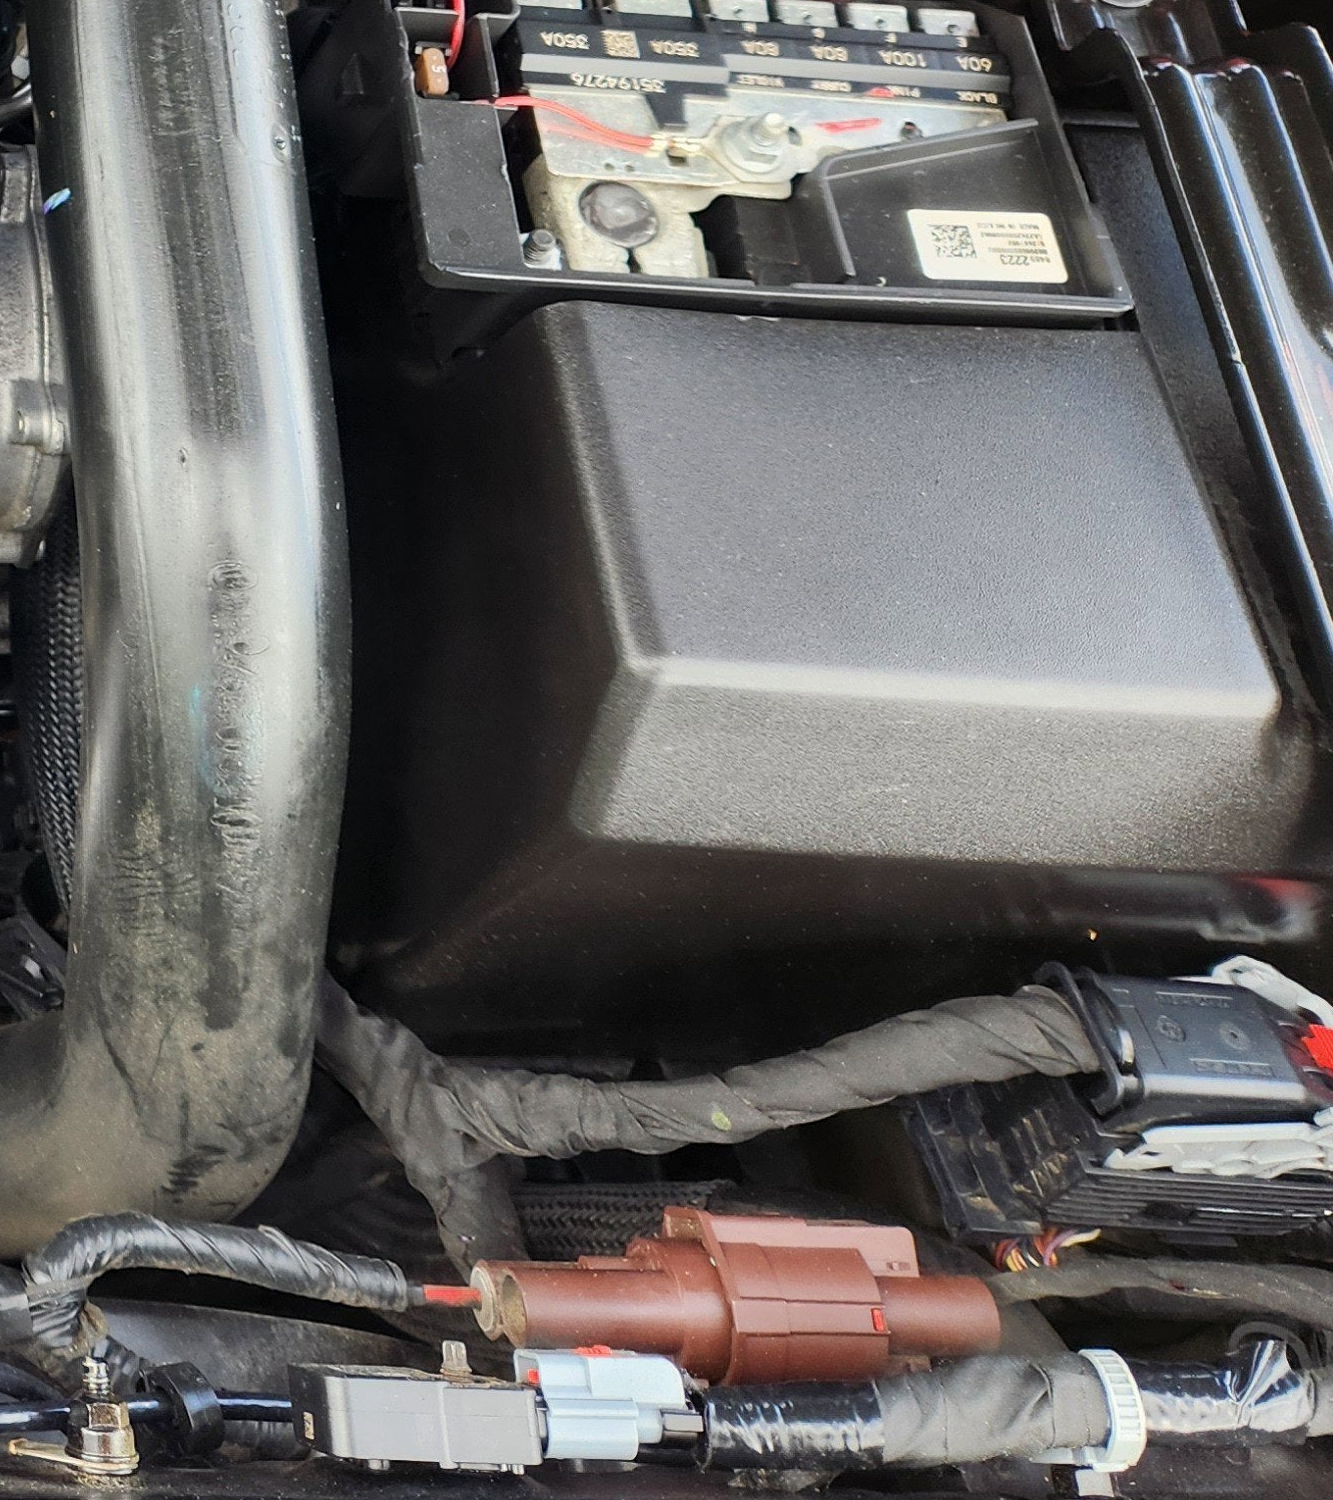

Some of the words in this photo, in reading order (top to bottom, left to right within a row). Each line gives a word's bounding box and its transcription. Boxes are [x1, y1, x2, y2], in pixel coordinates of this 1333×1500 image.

[538, 31, 590, 52] 350A
[648, 40, 700, 58] 350A
[877, 50, 927, 68] 100A
[955, 56, 993, 72] 60A
[999, 254, 1029, 266] 2223
